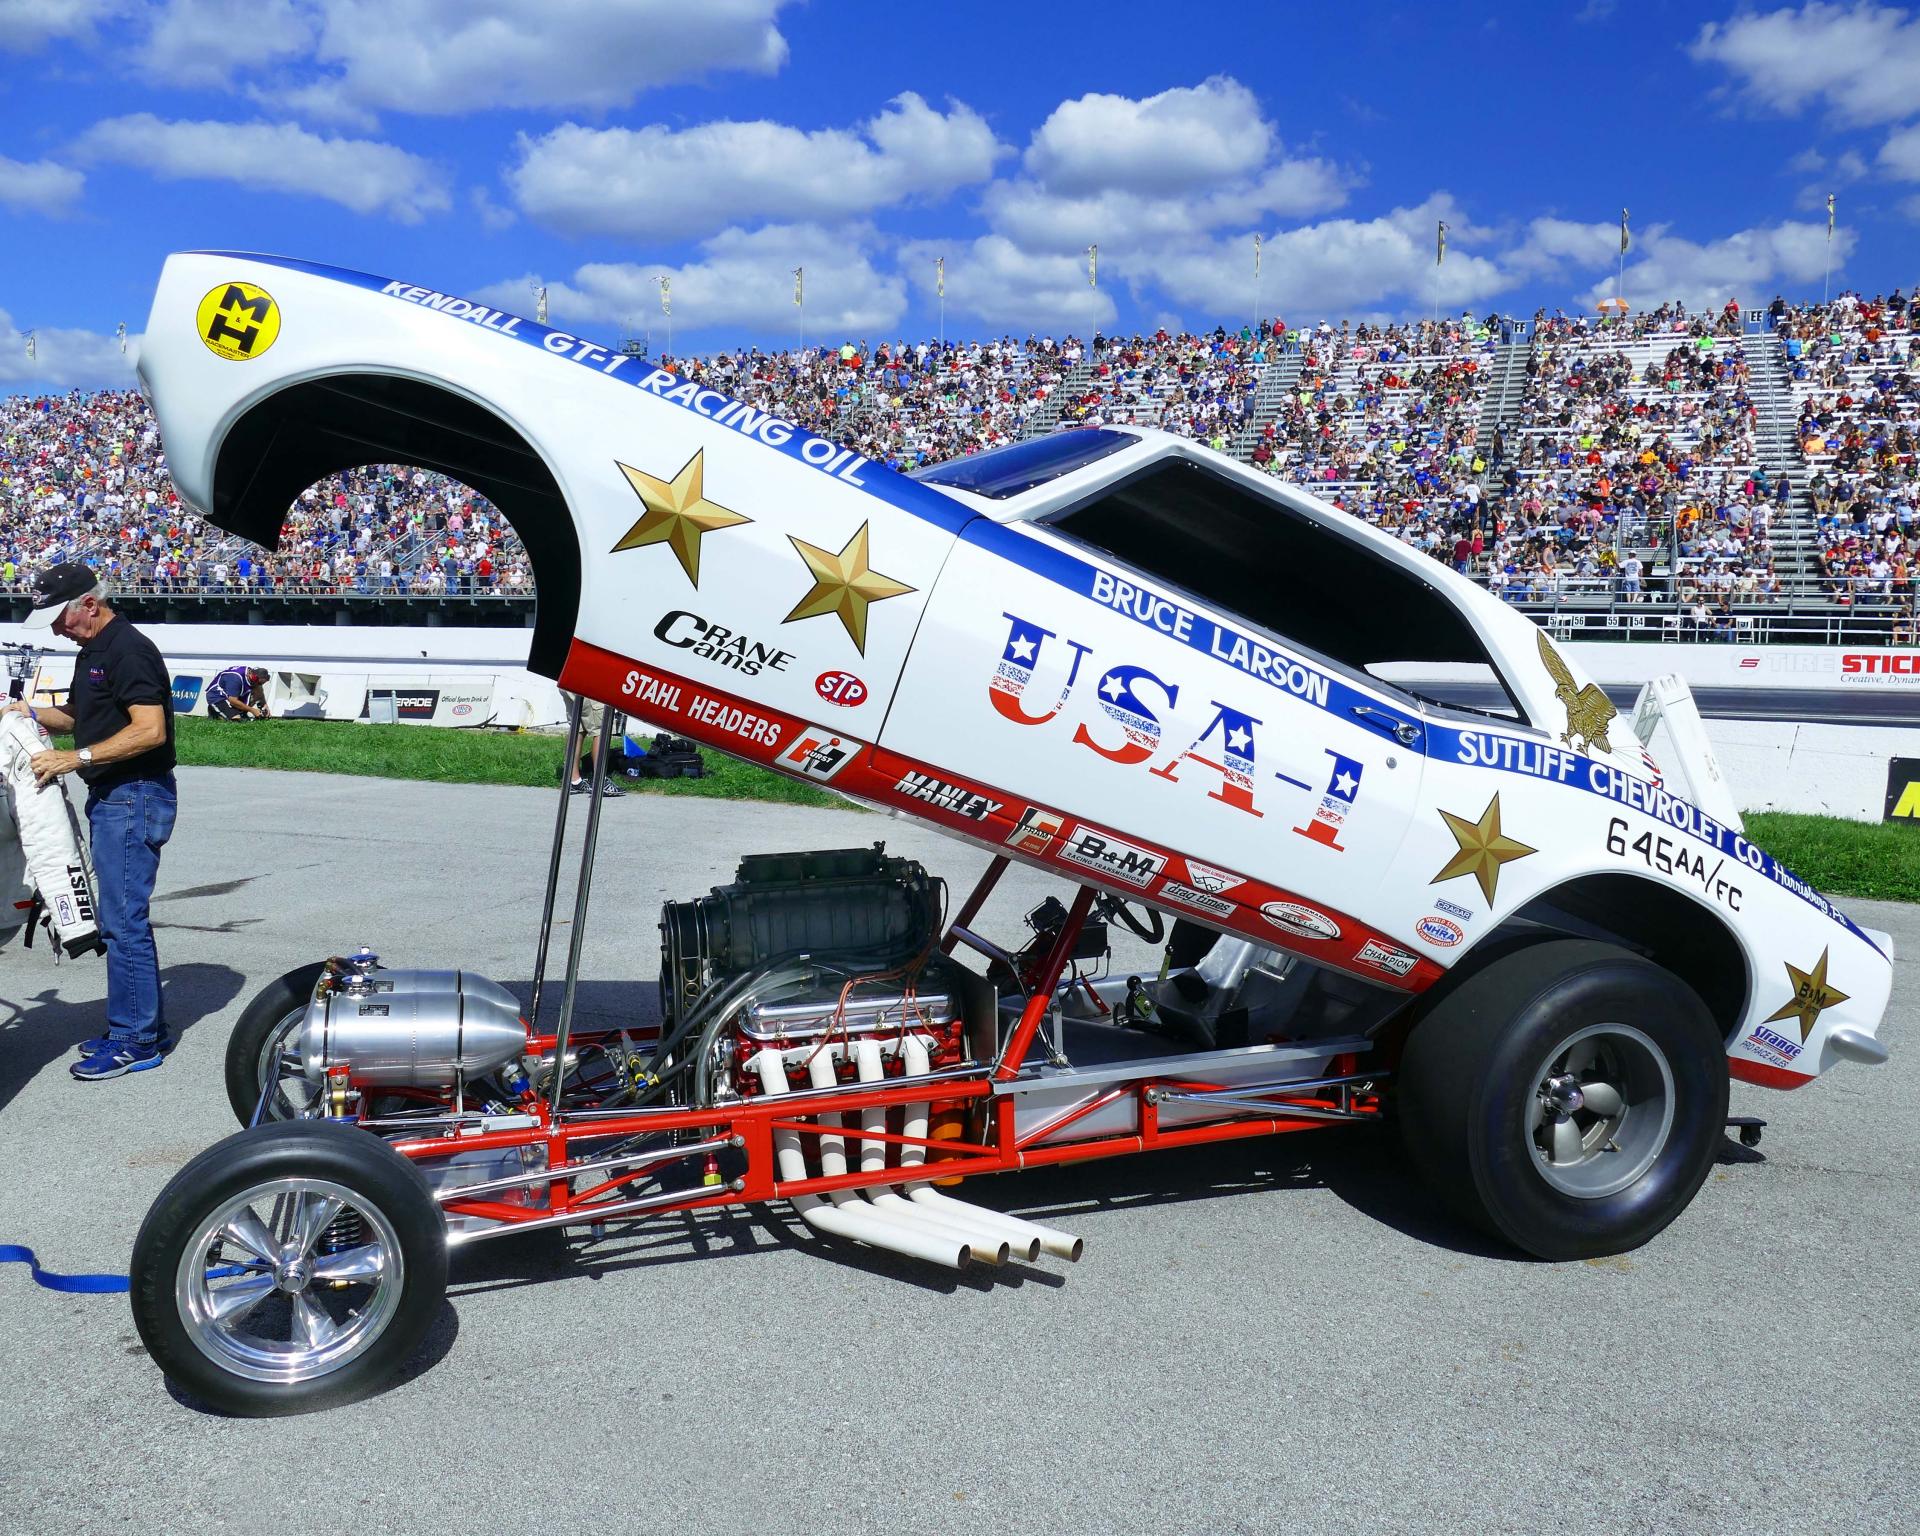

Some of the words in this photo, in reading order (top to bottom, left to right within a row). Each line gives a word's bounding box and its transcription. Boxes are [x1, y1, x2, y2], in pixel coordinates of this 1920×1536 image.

[219, 285, 272, 324] M
[207, 313, 260, 354] H
[206, 339, 250, 358] RACEMASTER
[380, 280, 523, 337] KENDALL
[543, 332, 630, 374] GT-1
[637, 369, 795, 446] RACING
[802, 438, 869, 487] OIL
[1574, 616, 1584, 626] 56
[1608, 616, 1618, 626] 55
[1634, 617, 1643, 626] 54
[654, 610, 797, 672] CRANE
[1091, 570, 1196, 642] BRUCE
[1210, 627, 1330, 707] LARSON
[441, 695, 456, 703] Official
[457, 695, 470, 704] Sports
[820, 674, 862, 699] STP
[621, 670, 683, 712] STAHL
[687, 695, 782, 747] HEADERS
[803, 748, 833, 764] HURST
[893, 770, 1004, 822] MANLEY
[1457, 731, 1576, 782] SUTLIFF
[1588, 762, 1727, 848] CHEVROLET
[1734, 836, 1767, 874] CO.
[1022, 824, 1050, 839] FRAM
[1066, 852, 1093, 865] RACING
[1094, 861, 1146, 885] TRANSMISSIONS
[1075, 834, 1156, 878] B&M
[66, 864, 95, 921] DEIST
[1167, 884, 1196, 900] drag
[1197, 894, 1231, 911] times
[1281, 903, 1331, 923] PERFORMANCE
[1425, 917, 1446, 925] WORLD
[1437, 901, 1470, 920] CRAGAR
[1417, 929, 1454, 947] CHAMPIONSHIP
[1423, 923, 1455, 941] NHRA
[1365, 948, 1411, 970] CHAMPION
[1740, 1040, 1755, 1051] PRO
[1752, 1046, 1771, 1059] RACE
[1768, 1055, 1789, 1067] AXLES
[1755, 1026, 1801, 1057] Strange
